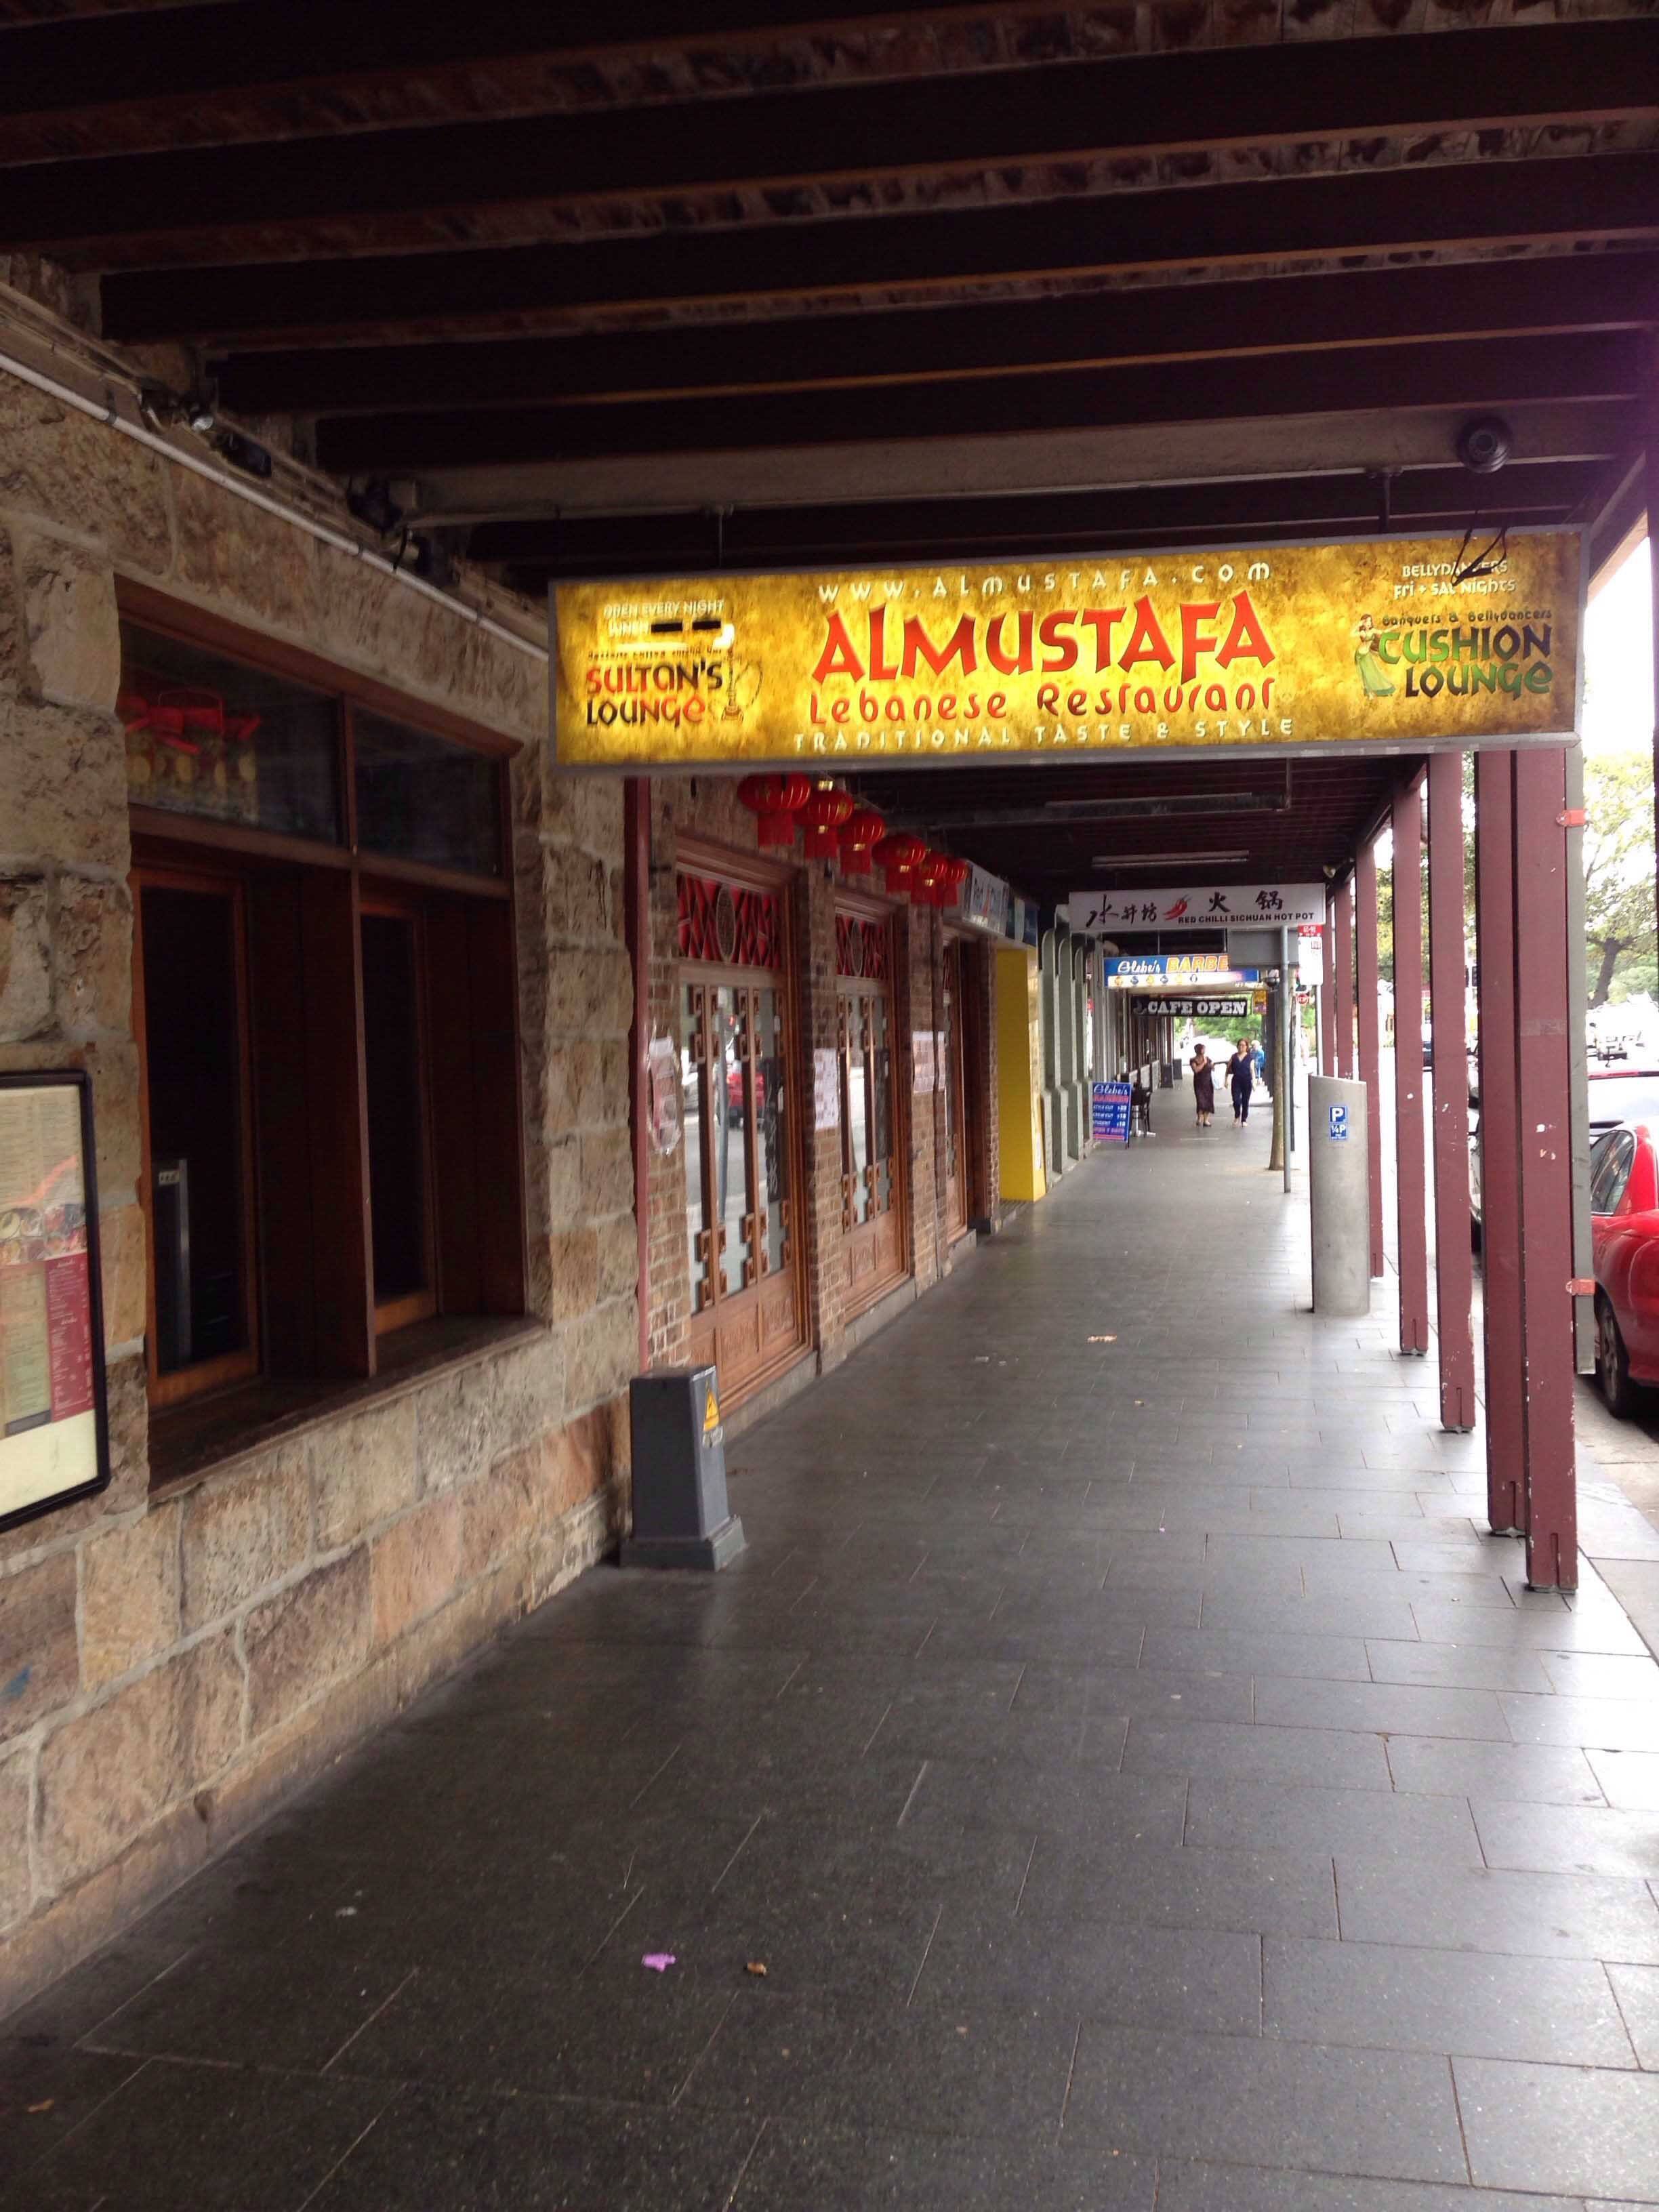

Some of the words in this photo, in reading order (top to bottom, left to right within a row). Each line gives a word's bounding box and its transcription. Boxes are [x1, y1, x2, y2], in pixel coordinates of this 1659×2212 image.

[603, 604, 638, 619] OPEN
[642, 601, 680, 617] EVERY
[683, 599, 724, 615] NIGHT
[811, 590, 1275, 684] ALMUSTAFA
[1378, 623, 1552, 664] CUSHION
[1405, 661, 1553, 701] LOUNGE
[587, 695, 705, 728] LOUNGE
[811, 687, 1006, 724] Lebanese
[1038, 677, 1275, 716] Restaurant
[794, 726, 1010, 754] TRADITIONAL
[1035, 722, 1133, 743] TASTE
[1156, 722, 1170, 739] &
[1195, 718, 1293, 738] STYLE
[1179, 916, 1197, 924] RED
[1199, 915, 1228, 924] CHILLI
[1230, 914, 1271, 922] SICHUAN
[1273, 913, 1294, 921] HOT
[1295, 912, 1314, 920] POT
[1166, 956, 1229, 972] BARBE
[1147, 1001, 1193, 1015] CAFE
[1197, 1001, 1246, 1015] OPEN
[1332, 1107, 1344, 1122] P
